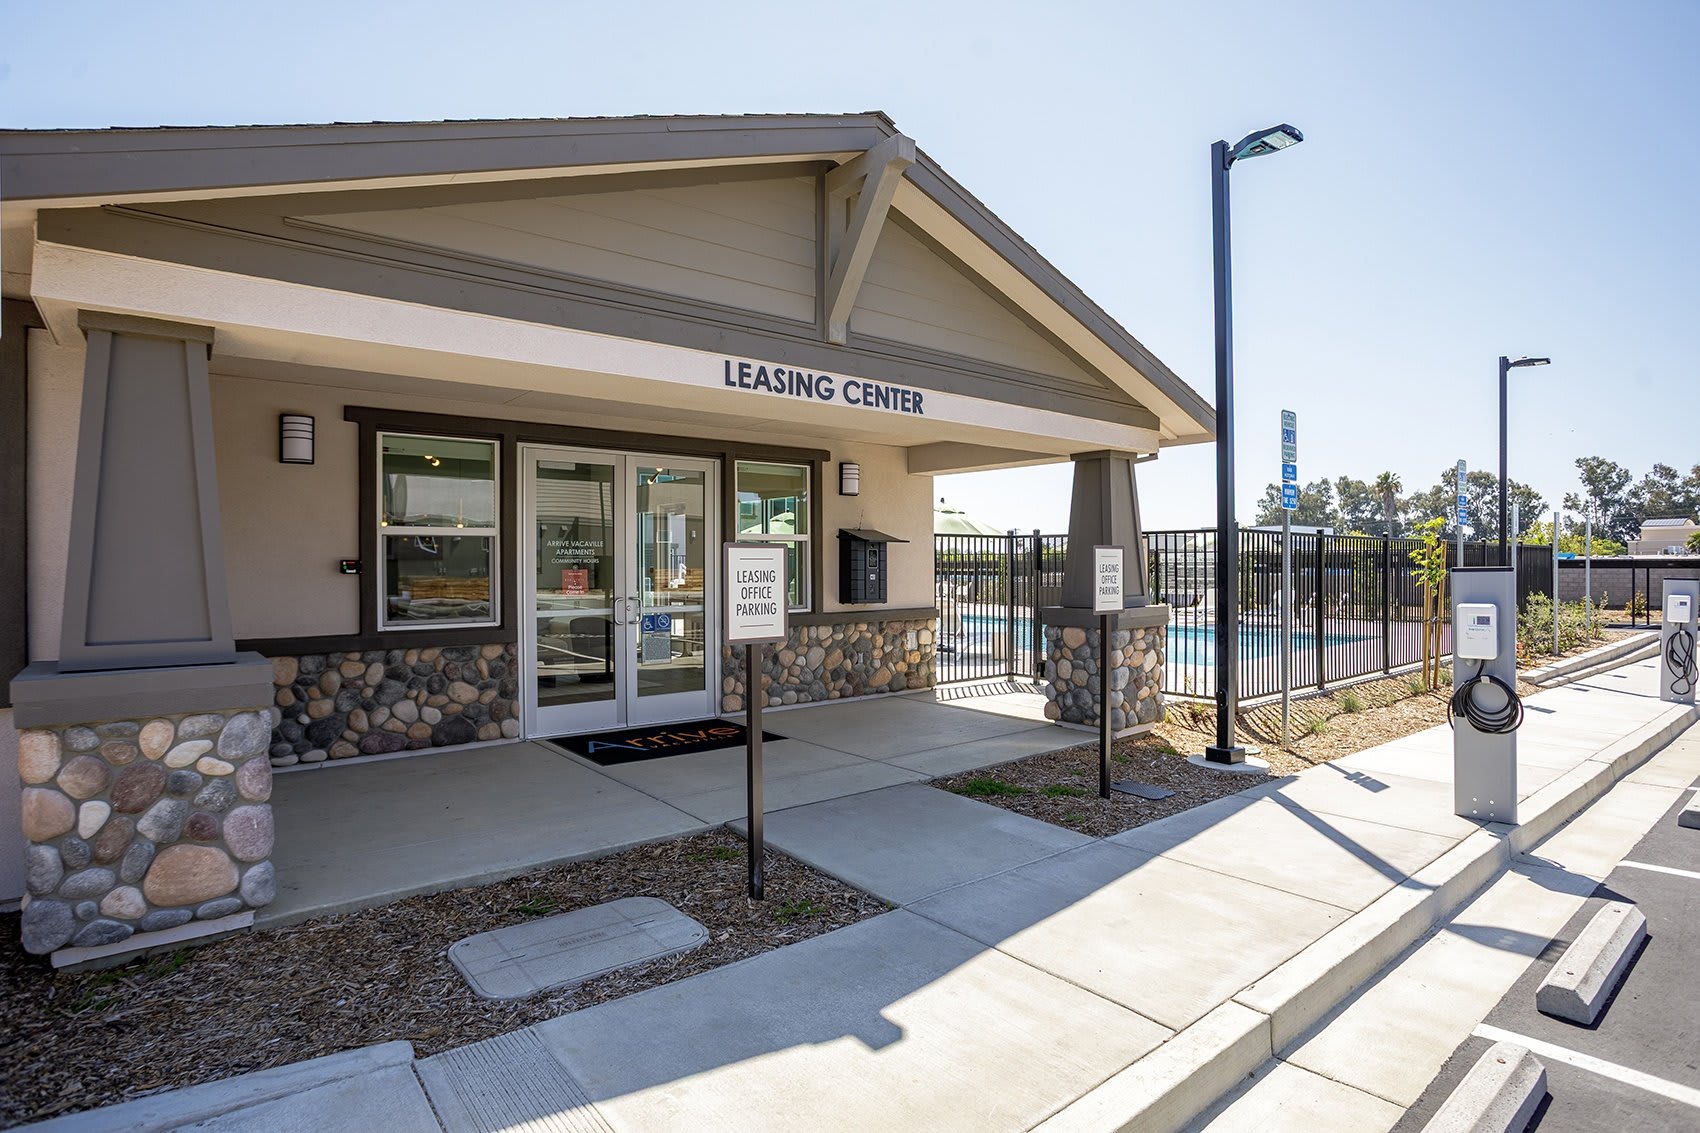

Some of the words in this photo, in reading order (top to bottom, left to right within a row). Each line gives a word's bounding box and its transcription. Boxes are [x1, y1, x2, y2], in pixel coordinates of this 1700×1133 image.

[725, 360, 835, 401] LEASING
[843, 380, 924, 414] CENTER
[1099, 563, 1120, 573] LEASING
[736, 570, 776, 583] LEASING
[1101, 574, 1117, 584] OFFICE
[741, 586, 772, 600] OFFICE
[1099, 586, 1120, 595] PARKING
[736, 602, 777, 616] PARKING
[588, 728, 740, 753] Arrive
